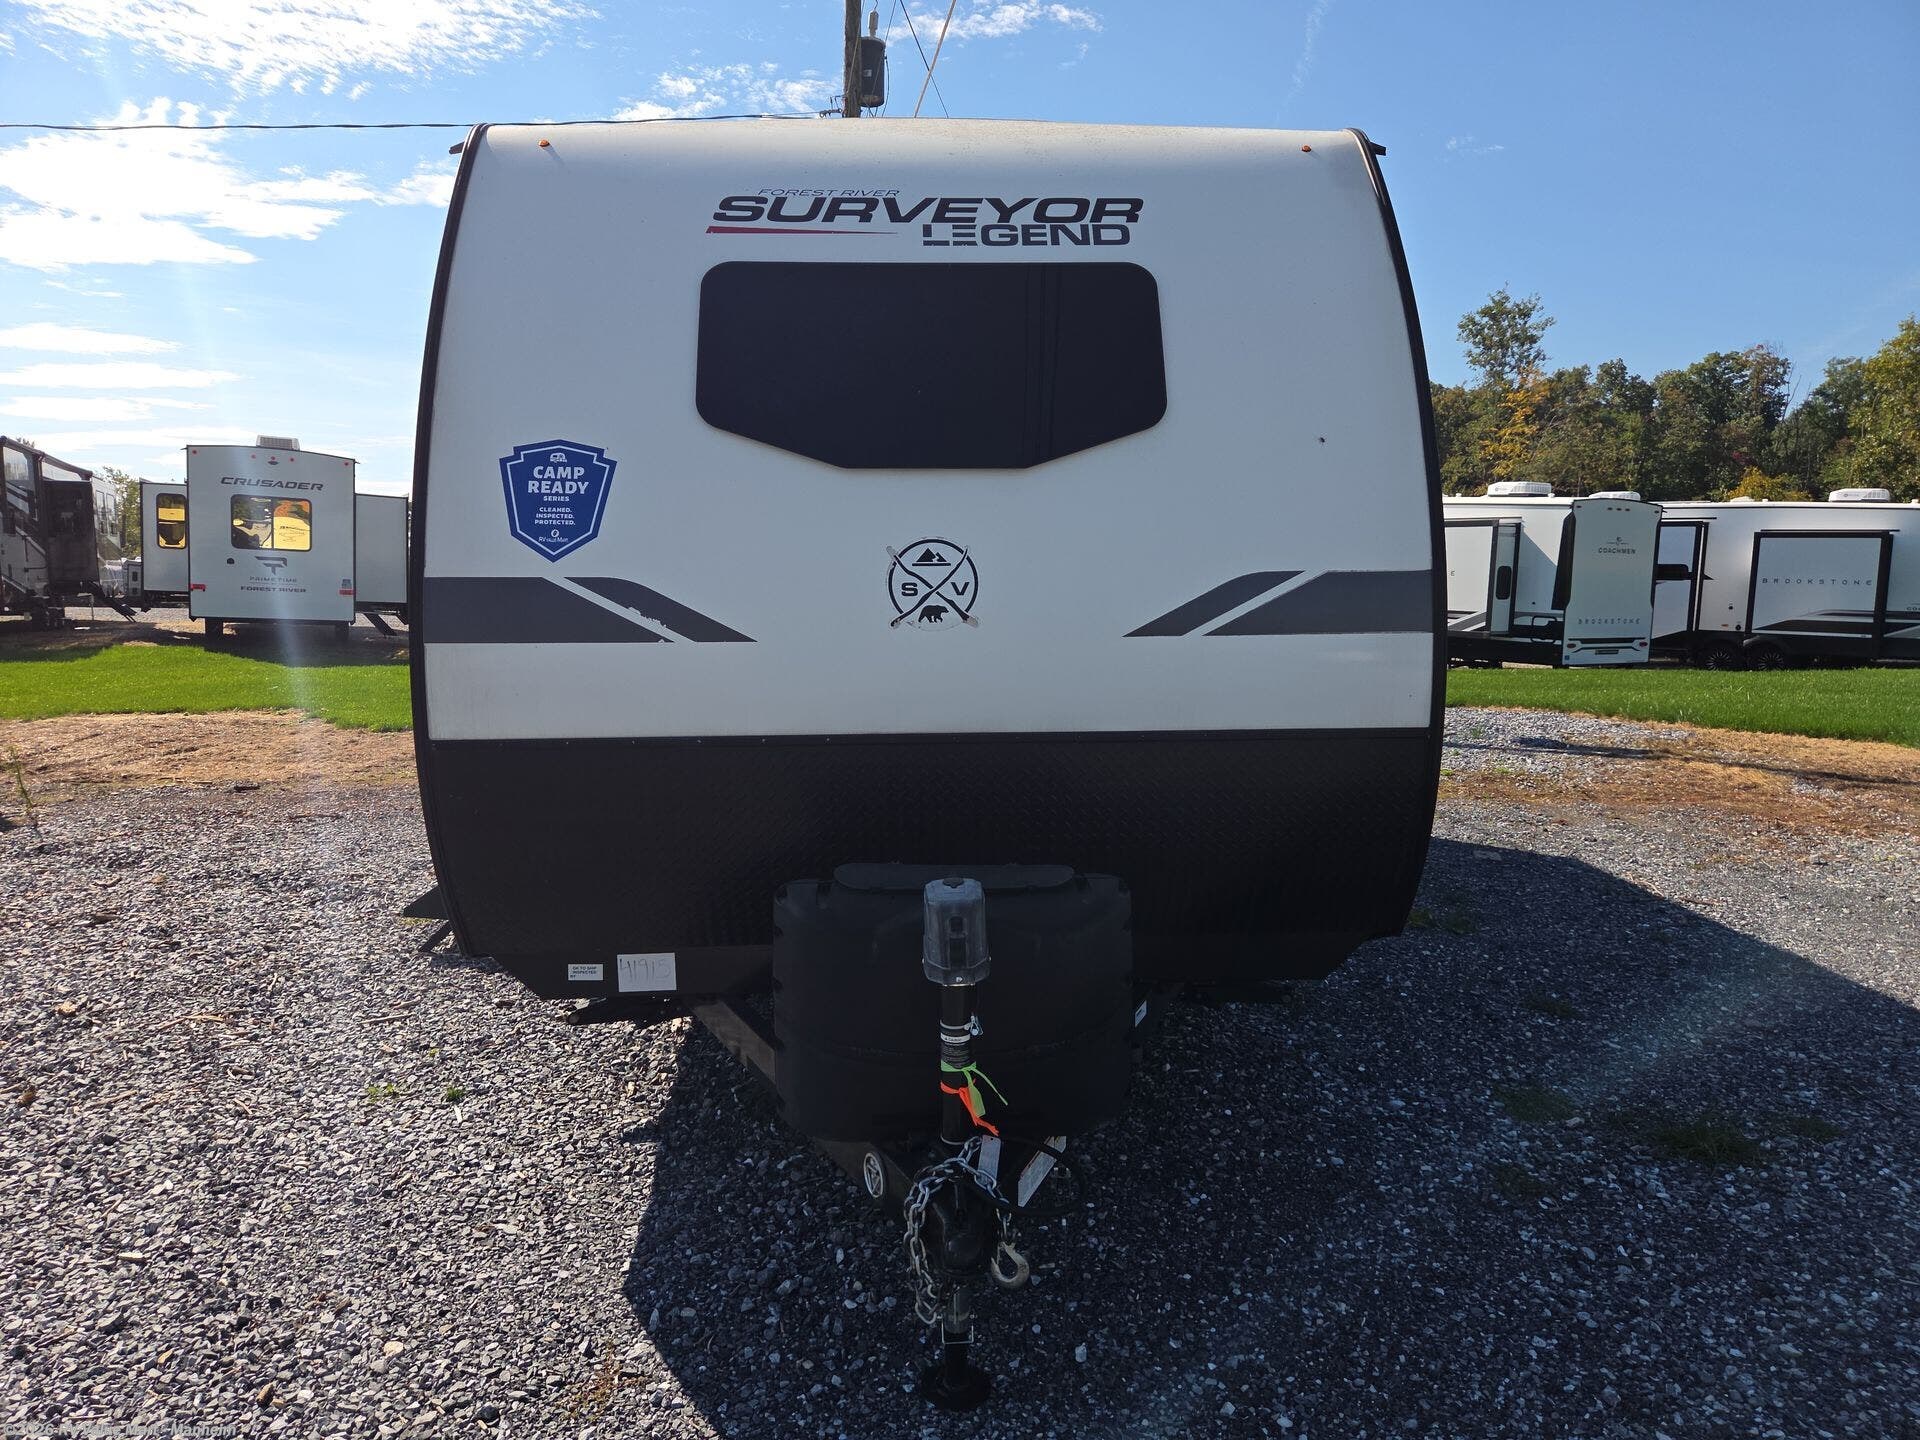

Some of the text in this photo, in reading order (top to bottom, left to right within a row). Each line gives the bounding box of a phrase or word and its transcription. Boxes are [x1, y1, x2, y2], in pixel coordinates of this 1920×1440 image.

[758, 189, 900, 198] FOREST RIVER
[712, 196, 1144, 223] SURVEYOR
[922, 224, 1130, 247] LEGEND
[533, 465, 585, 480] CAMP
[220, 476, 324, 491] CRUSADER
[527, 480, 590, 495] READY
[1598, 547, 1636, 555] COACHMEN
[901, 581, 970, 597] S V
[1762, 577, 1873, 586] BROOKSTONE
